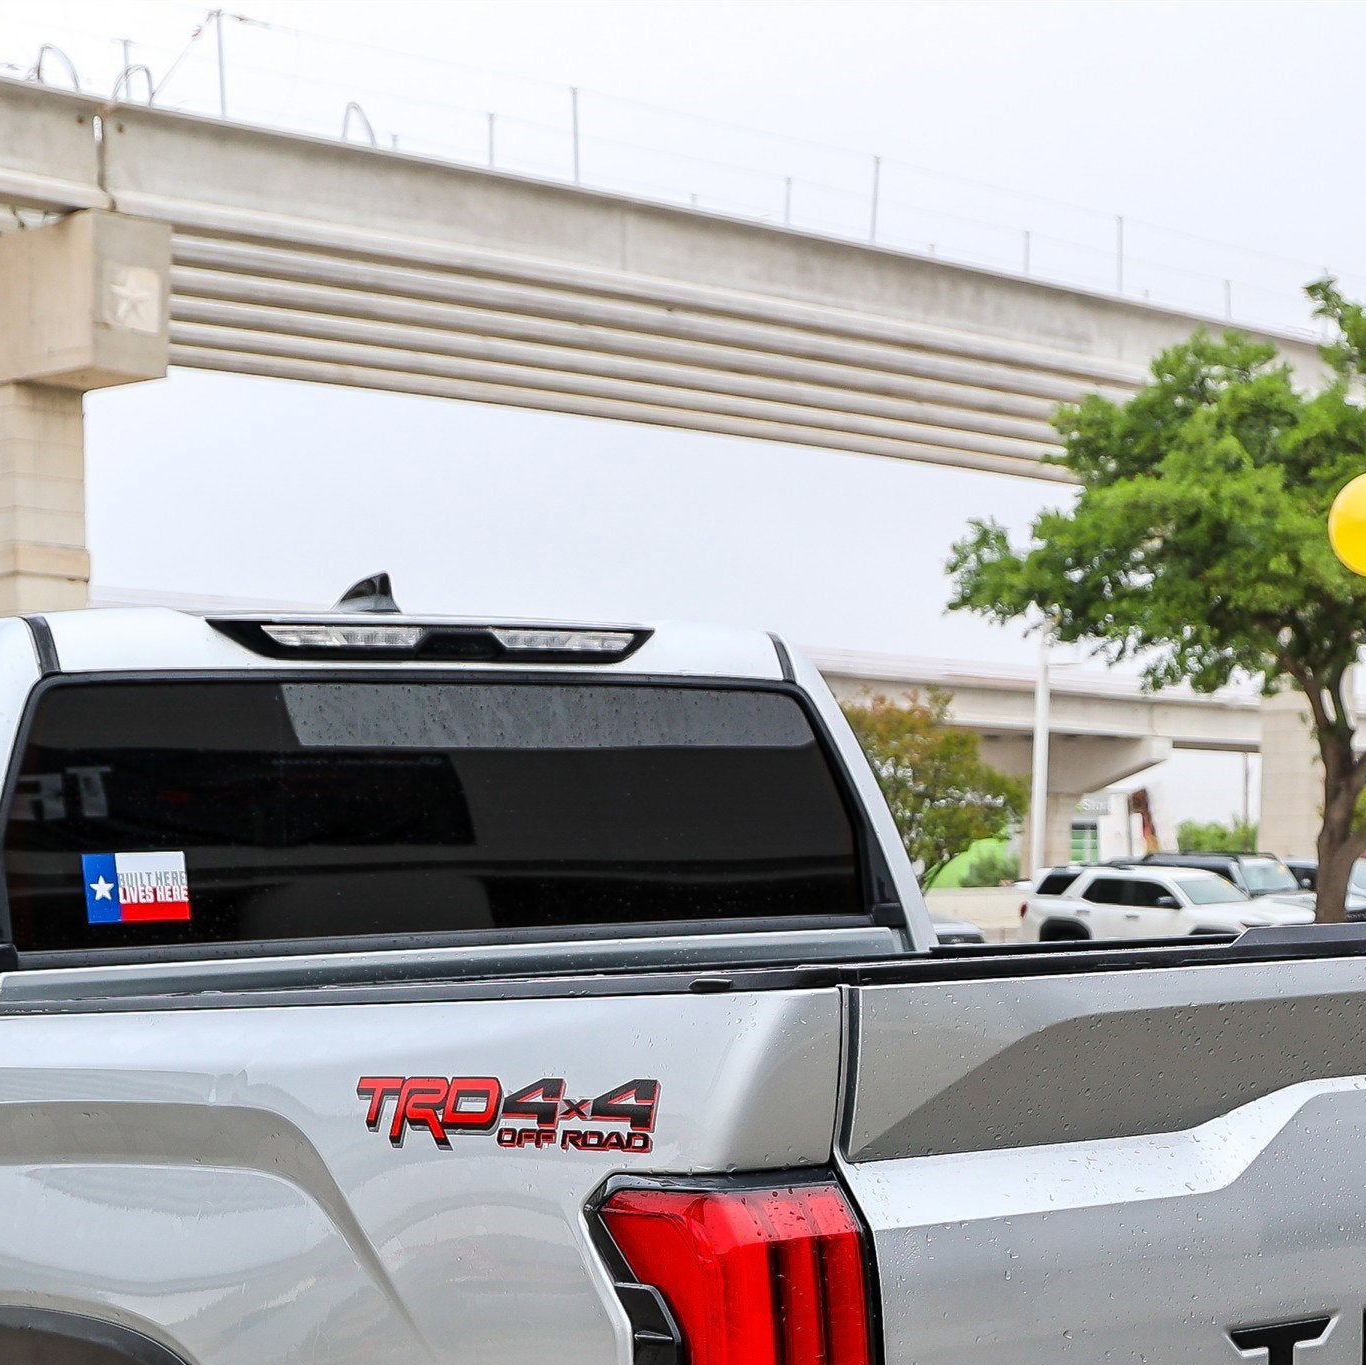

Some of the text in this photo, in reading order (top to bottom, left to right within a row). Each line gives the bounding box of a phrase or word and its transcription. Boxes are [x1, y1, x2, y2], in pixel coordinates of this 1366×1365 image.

[118, 870, 188, 888] BUILT HERE
[119, 884, 189, 905] LIVES HERE
[356, 1075, 504, 1152] TRD
[497, 1127, 655, 1155] OFF ROAD
